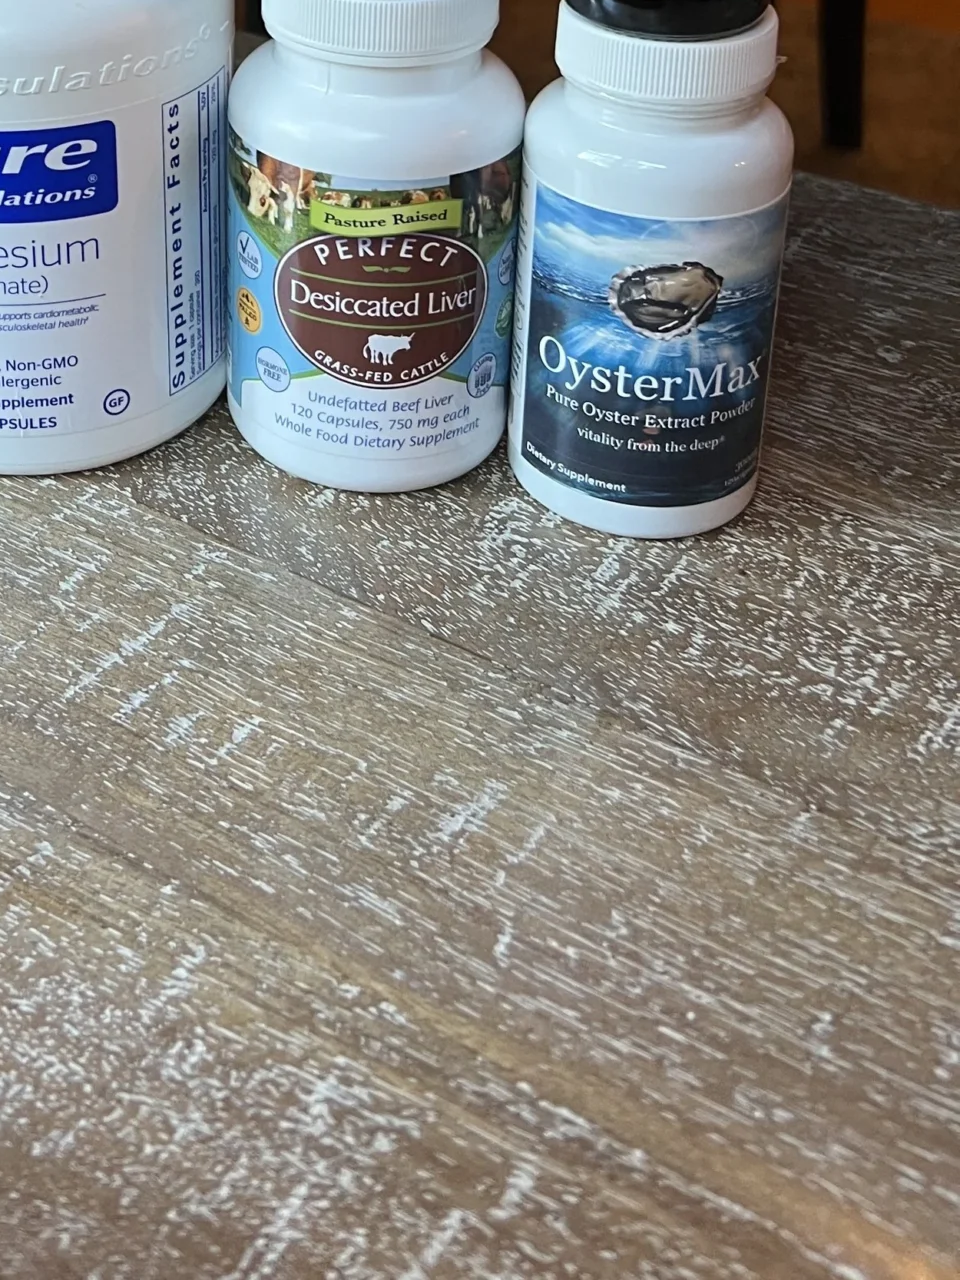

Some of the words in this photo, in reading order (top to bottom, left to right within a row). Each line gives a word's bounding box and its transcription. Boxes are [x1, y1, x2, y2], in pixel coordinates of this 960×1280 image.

[166, 103, 181, 190] Facts
[323, 212, 386, 228] Pasture
[392, 209, 448, 226] Raised
[313, 237, 459, 268] PERFECT
[168, 202, 188, 389] Supplement
[290, 279, 420, 318] Desiccated
[427, 287, 477, 315] Liver
[5, 355, 79, 372] Non-GMO
[262, 366, 282, 383] FREE
[314, 349, 393, 383] GRASS-FED
[400, 351, 450, 381] CATTLE
[539, 334, 762, 402] OysterMax
[108, 396, 125, 409] GF
[290, 402, 313, 419] 120
[316, 411, 383, 432] Capsules,
[388, 419, 413, 430] 750
[417, 414, 439, 428] mg
[443, 404, 470, 424] each
[307, 390, 387, 412] Undefatted
[391, 397, 422, 413] Beef
[424, 393, 454, 410] Liver
[545, 384, 580, 412] Pure
[582, 401, 640, 427] Oyster
[643, 414, 706, 429] Extract
[710, 397, 756, 425] Powder
[273, 411, 312, 436] Whole
[316, 429, 349, 445] Food
[353, 434, 405, 451] Dietary
[408, 417, 480, 448] Supplement
[576, 426, 624, 450] vitality
[627, 438, 661, 452] from
[665, 439, 687, 453] the
[526, 441, 557, 470] Dietary
[557, 462, 627, 493] Supplement
